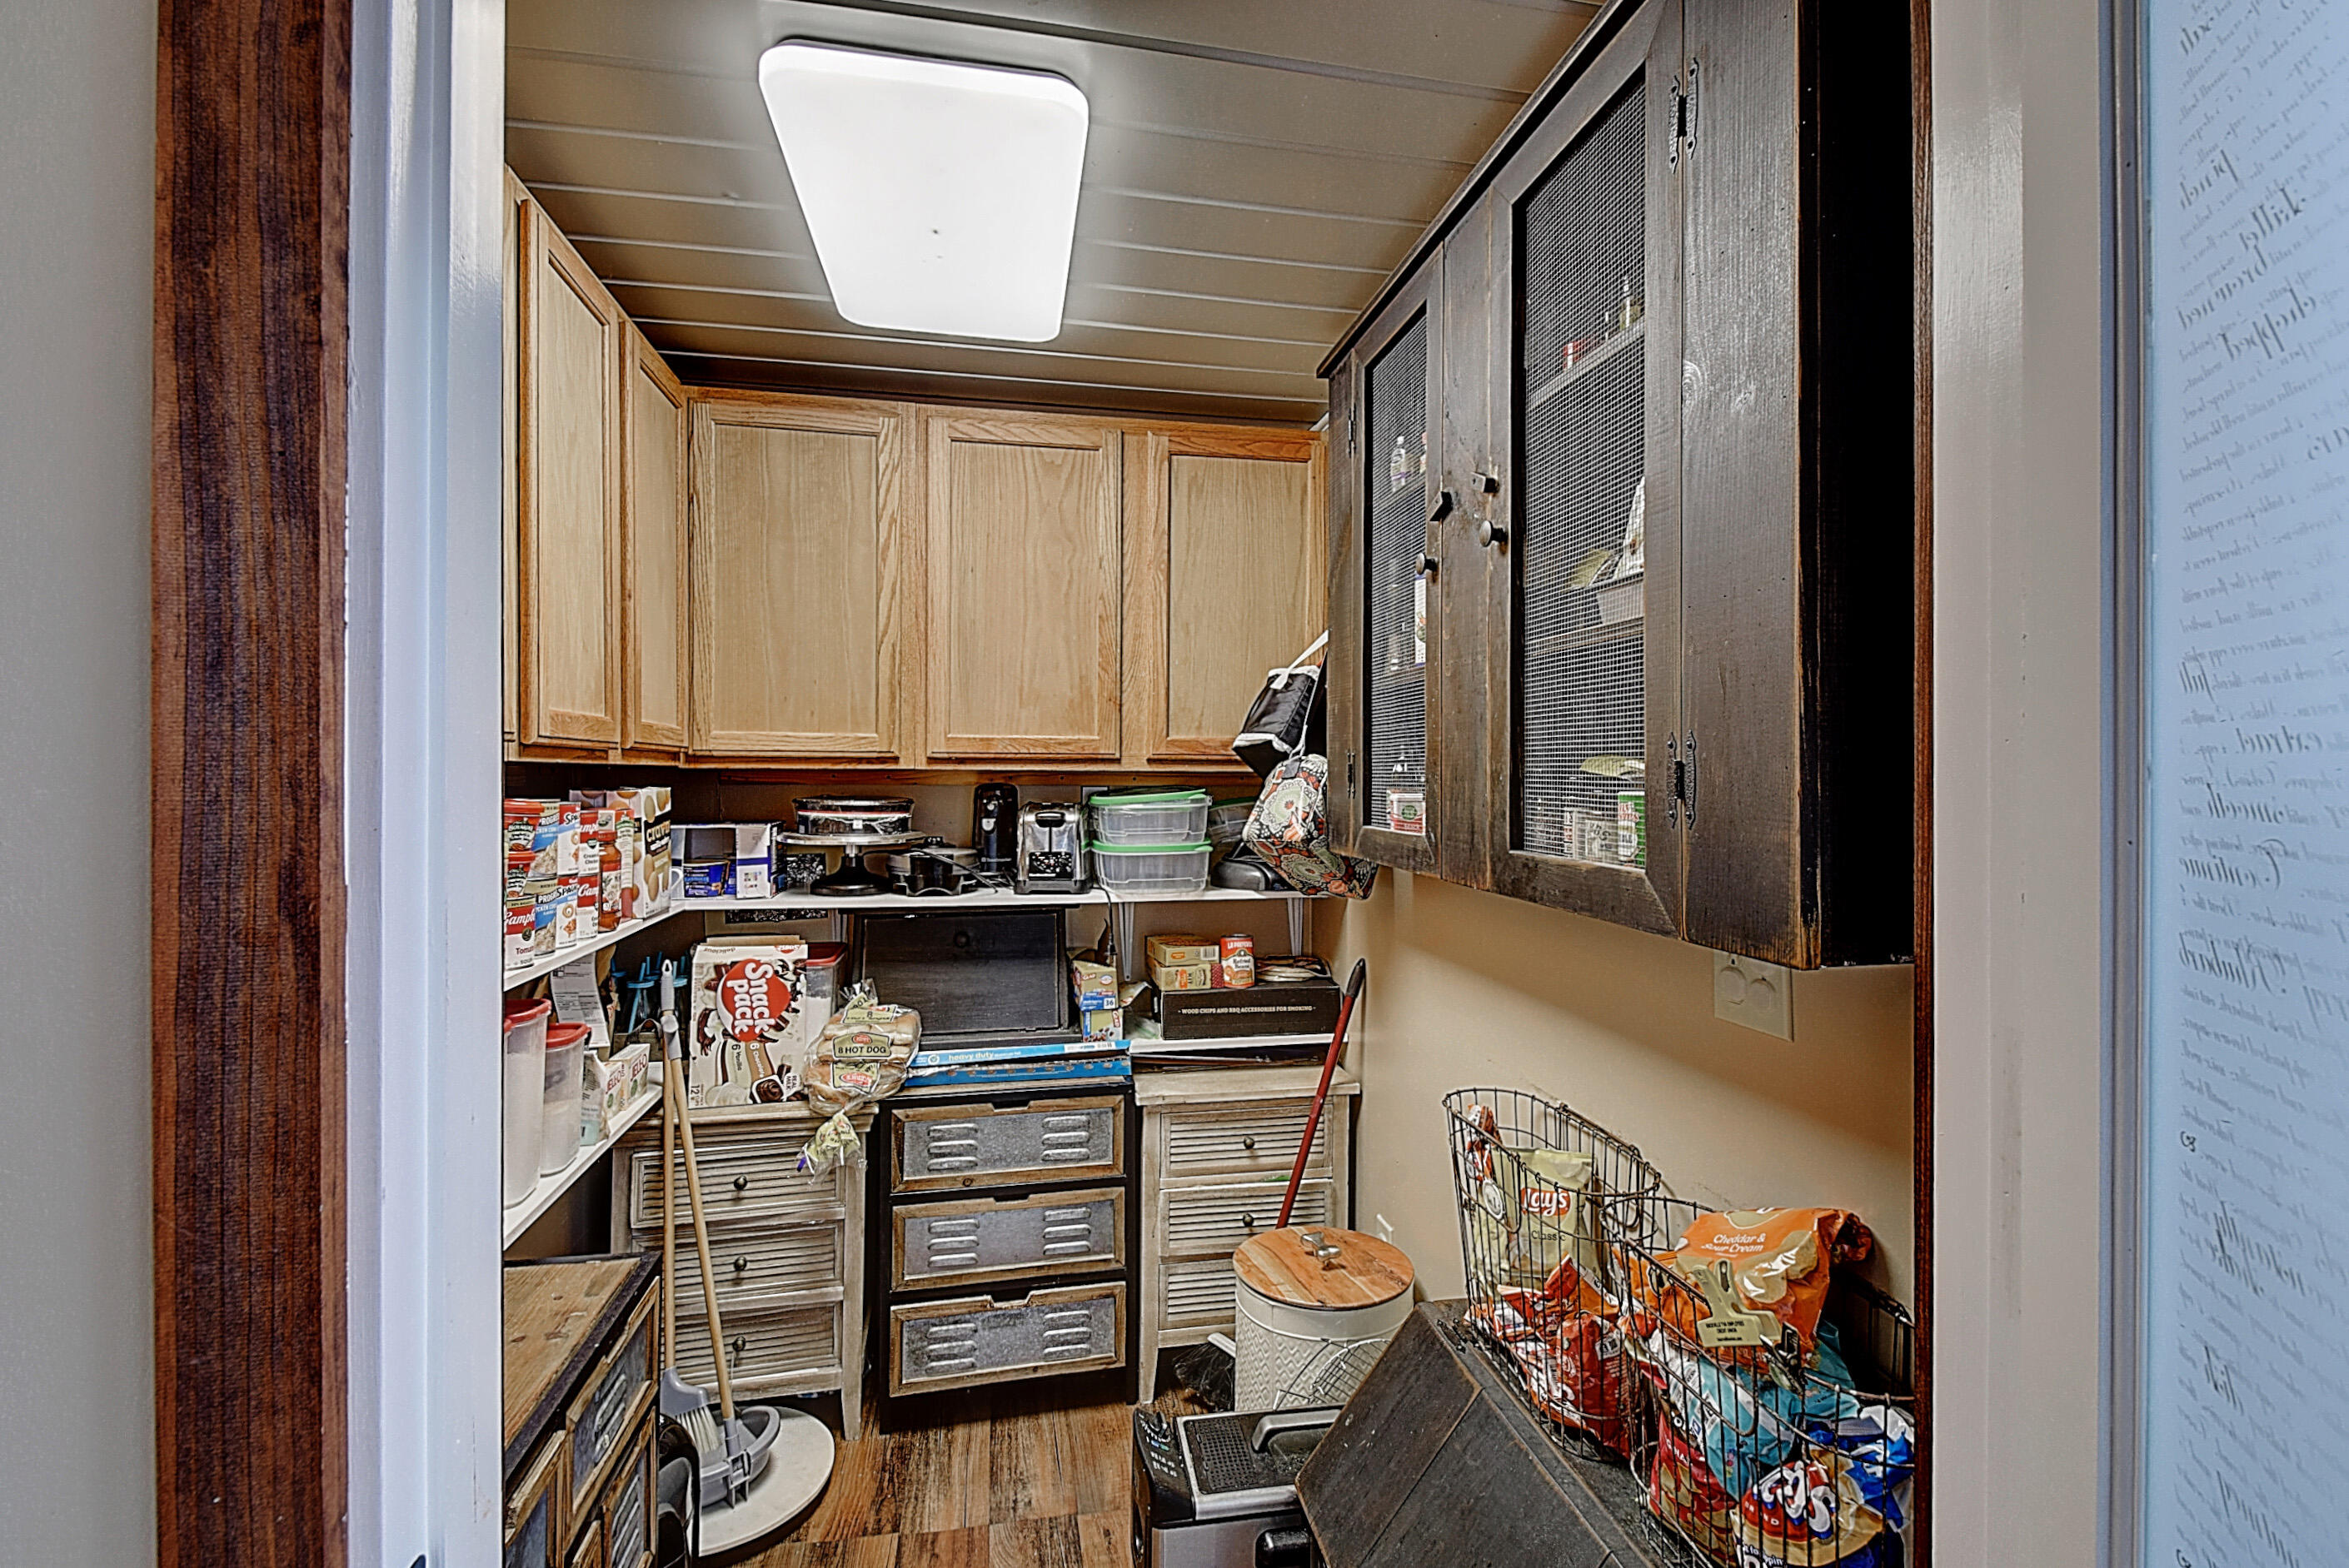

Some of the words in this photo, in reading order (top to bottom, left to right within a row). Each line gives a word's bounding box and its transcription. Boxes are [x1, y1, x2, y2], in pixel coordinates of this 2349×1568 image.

[845, 1046, 865, 1054] HOT
[866, 1046, 886, 1054] DOG
[948, 1053, 973, 1063] heavy
[975, 1052, 995, 1063] duty
[691, 1085, 700, 1094] 12
[1713, 1233, 1757, 1244] Cheddar
[1757, 1232, 1767, 1242] &
[1729, 1244, 1764, 1253] Cream
